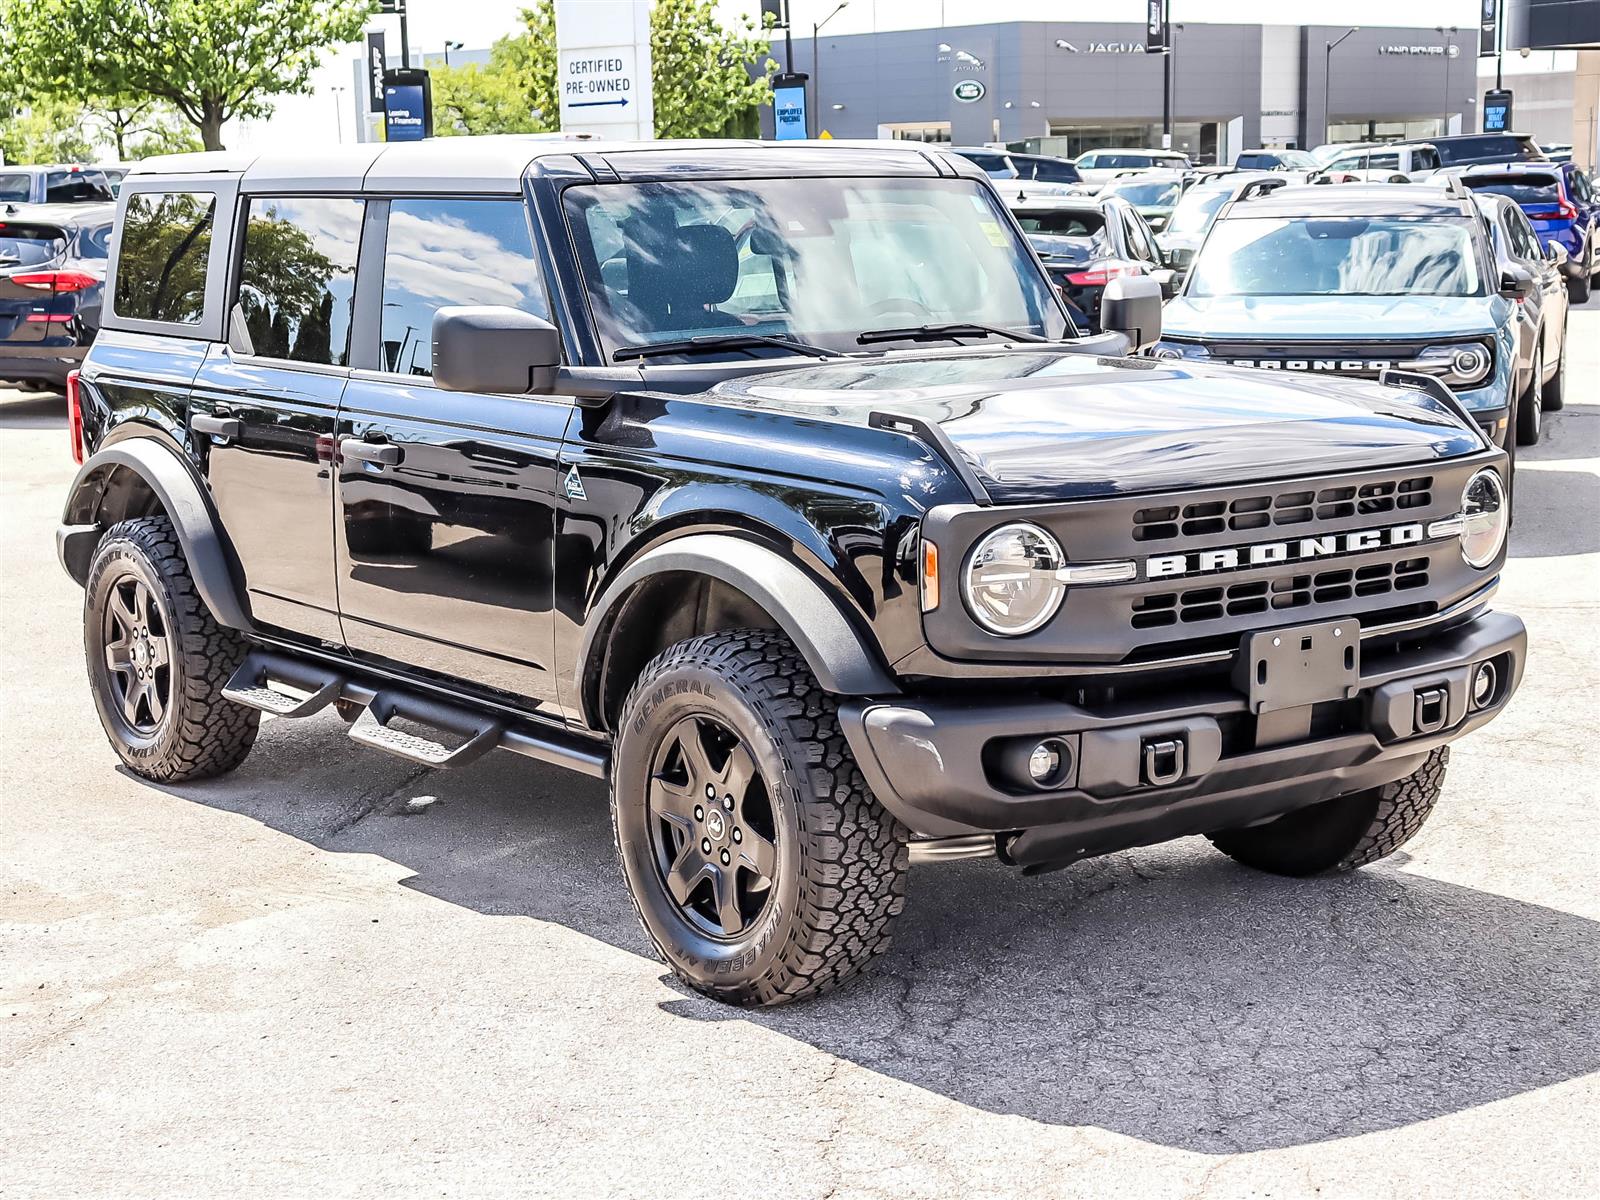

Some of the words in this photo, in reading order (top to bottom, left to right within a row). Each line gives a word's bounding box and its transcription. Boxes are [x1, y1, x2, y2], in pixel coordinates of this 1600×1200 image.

[1088, 42, 1146, 53] JAGUA
[569, 58, 623, 75] CERTIFIED
[566, 78, 630, 94] PRE-OWNED
[394, 117, 422, 126] Financing
[1233, 360, 1391, 370] BRONCO
[1146, 523, 1423, 578] BRONCO
[633, 679, 716, 735] GENERAL
